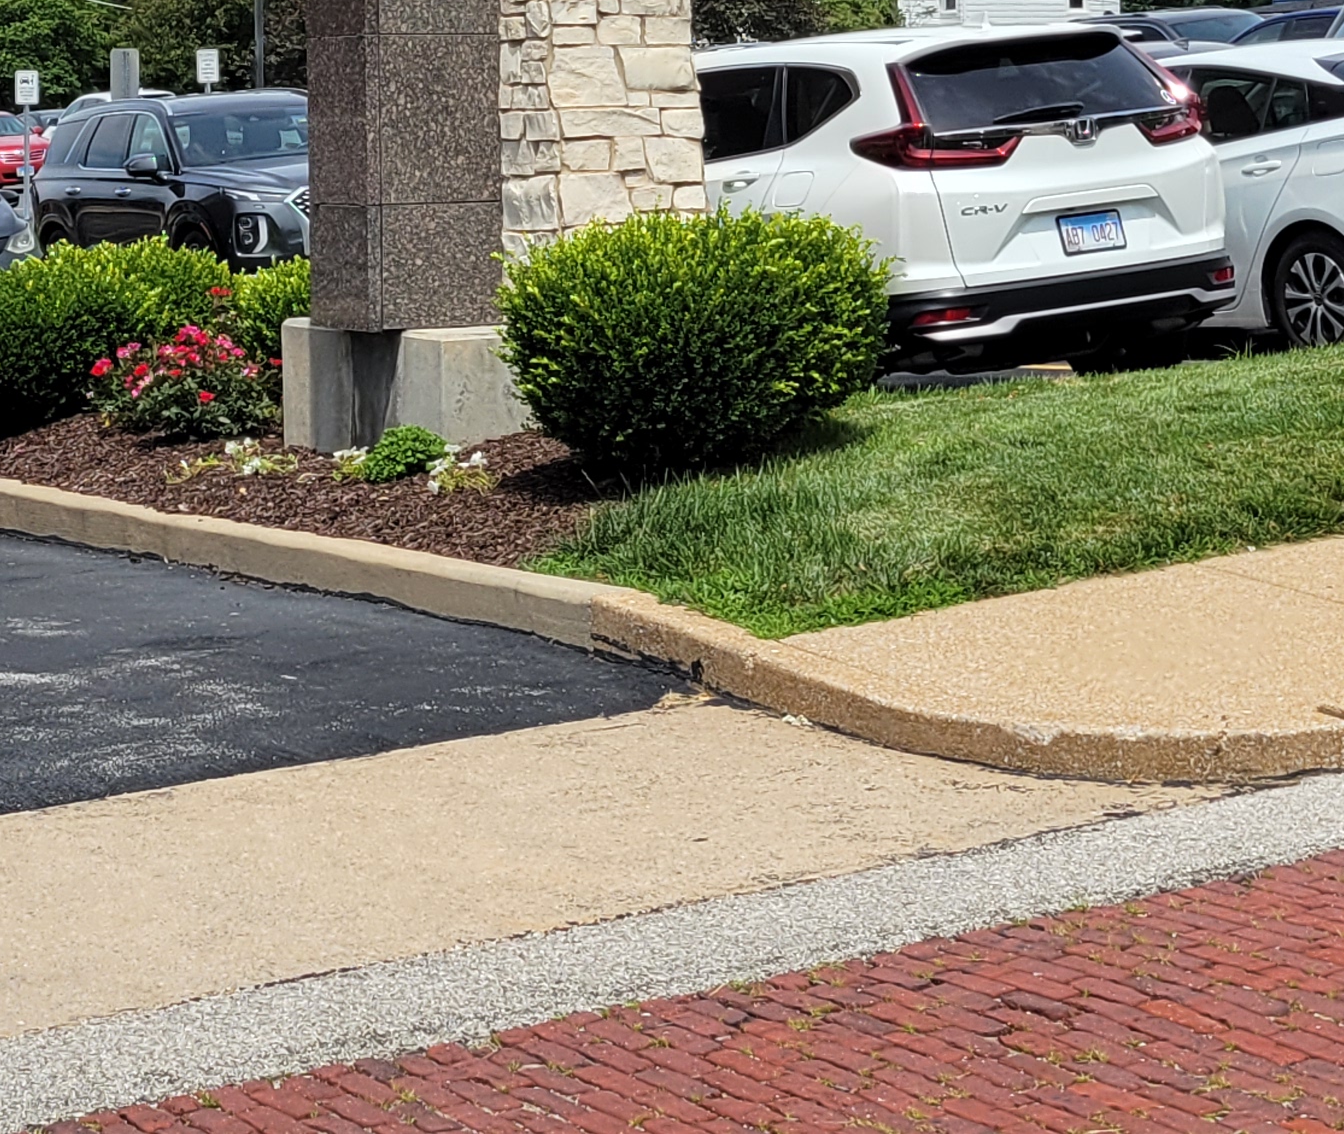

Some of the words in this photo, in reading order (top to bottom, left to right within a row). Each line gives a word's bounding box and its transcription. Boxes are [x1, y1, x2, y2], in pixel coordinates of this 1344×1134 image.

[960, 202, 1009, 217] CR-V
[1065, 225, 1085, 247] AB7
[1091, 221, 1119, 243] 0427
